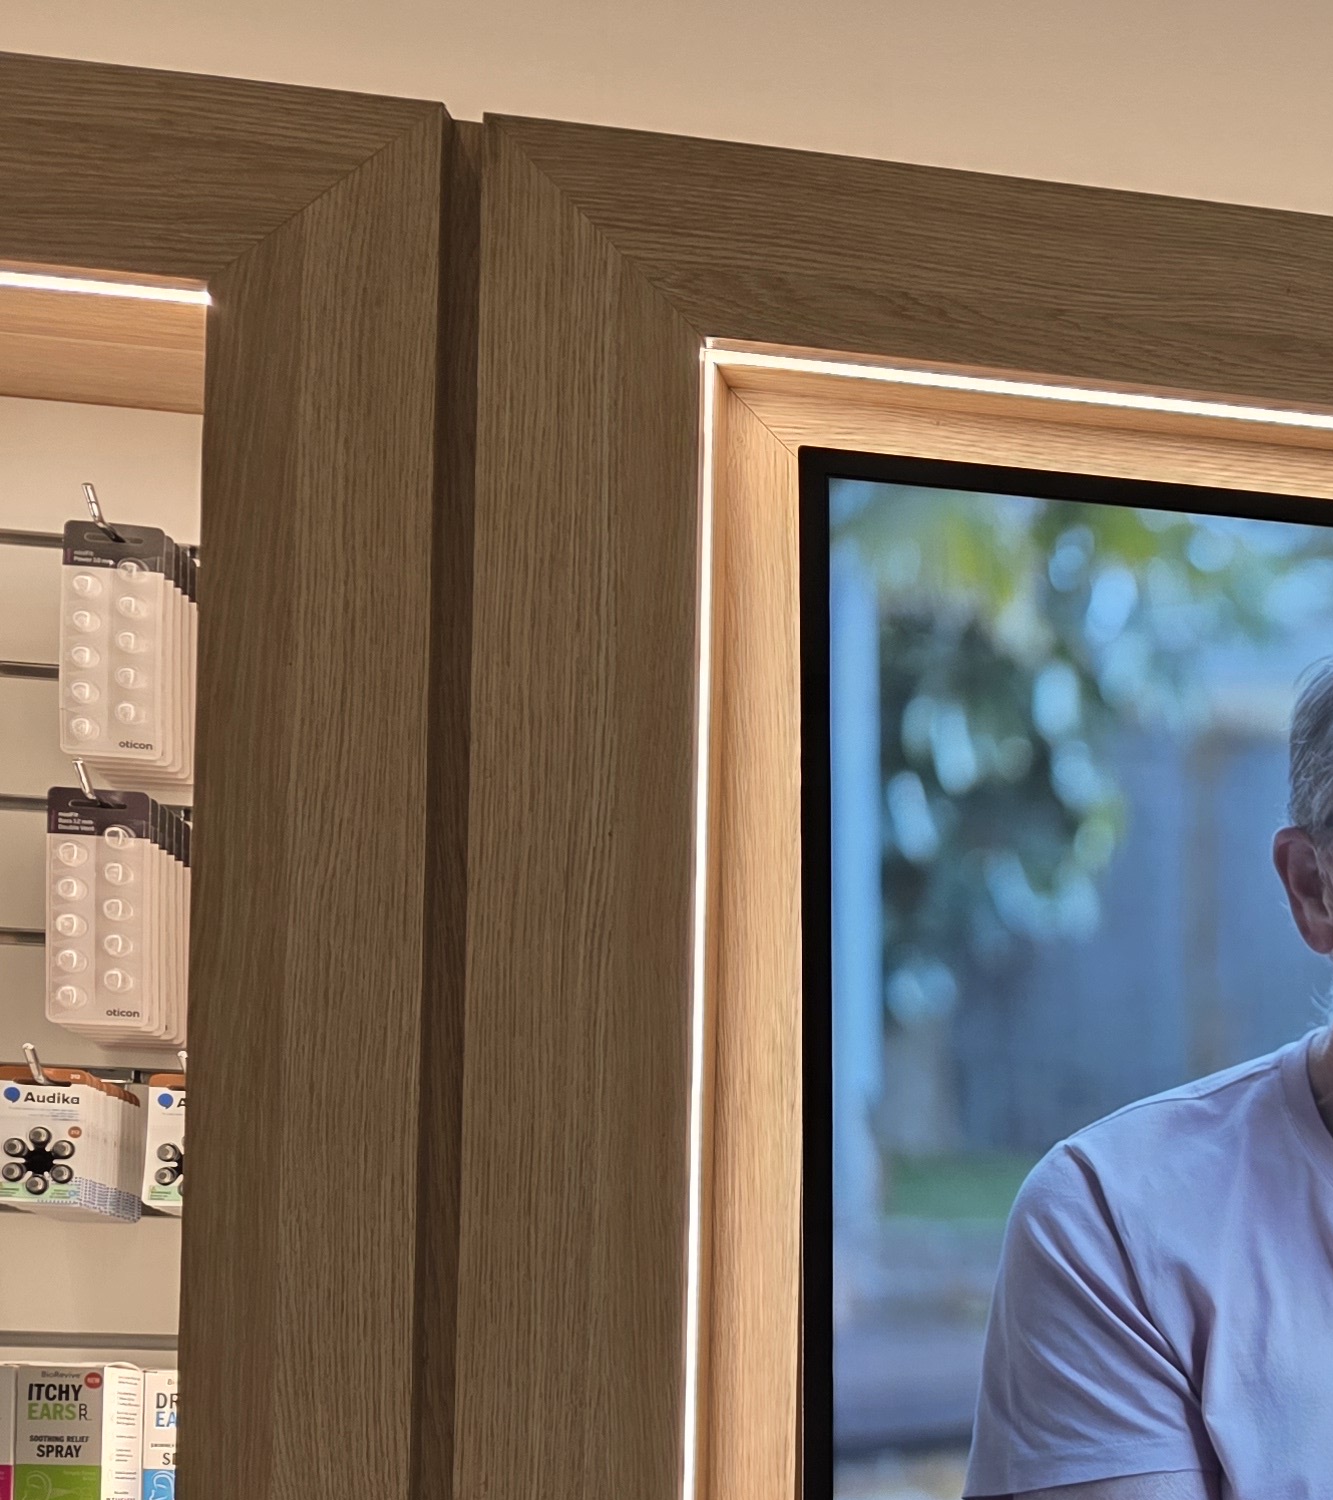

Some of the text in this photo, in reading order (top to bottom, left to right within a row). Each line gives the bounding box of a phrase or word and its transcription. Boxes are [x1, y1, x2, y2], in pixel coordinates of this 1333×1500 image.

[119, 740, 153, 750] oticon
[106, 1008, 140, 1018] oticon
[24, 1091, 80, 1105] Audika
[28, 1383, 82, 1401] ITCHY
[36, 1444, 82, 1458] SPRAY
